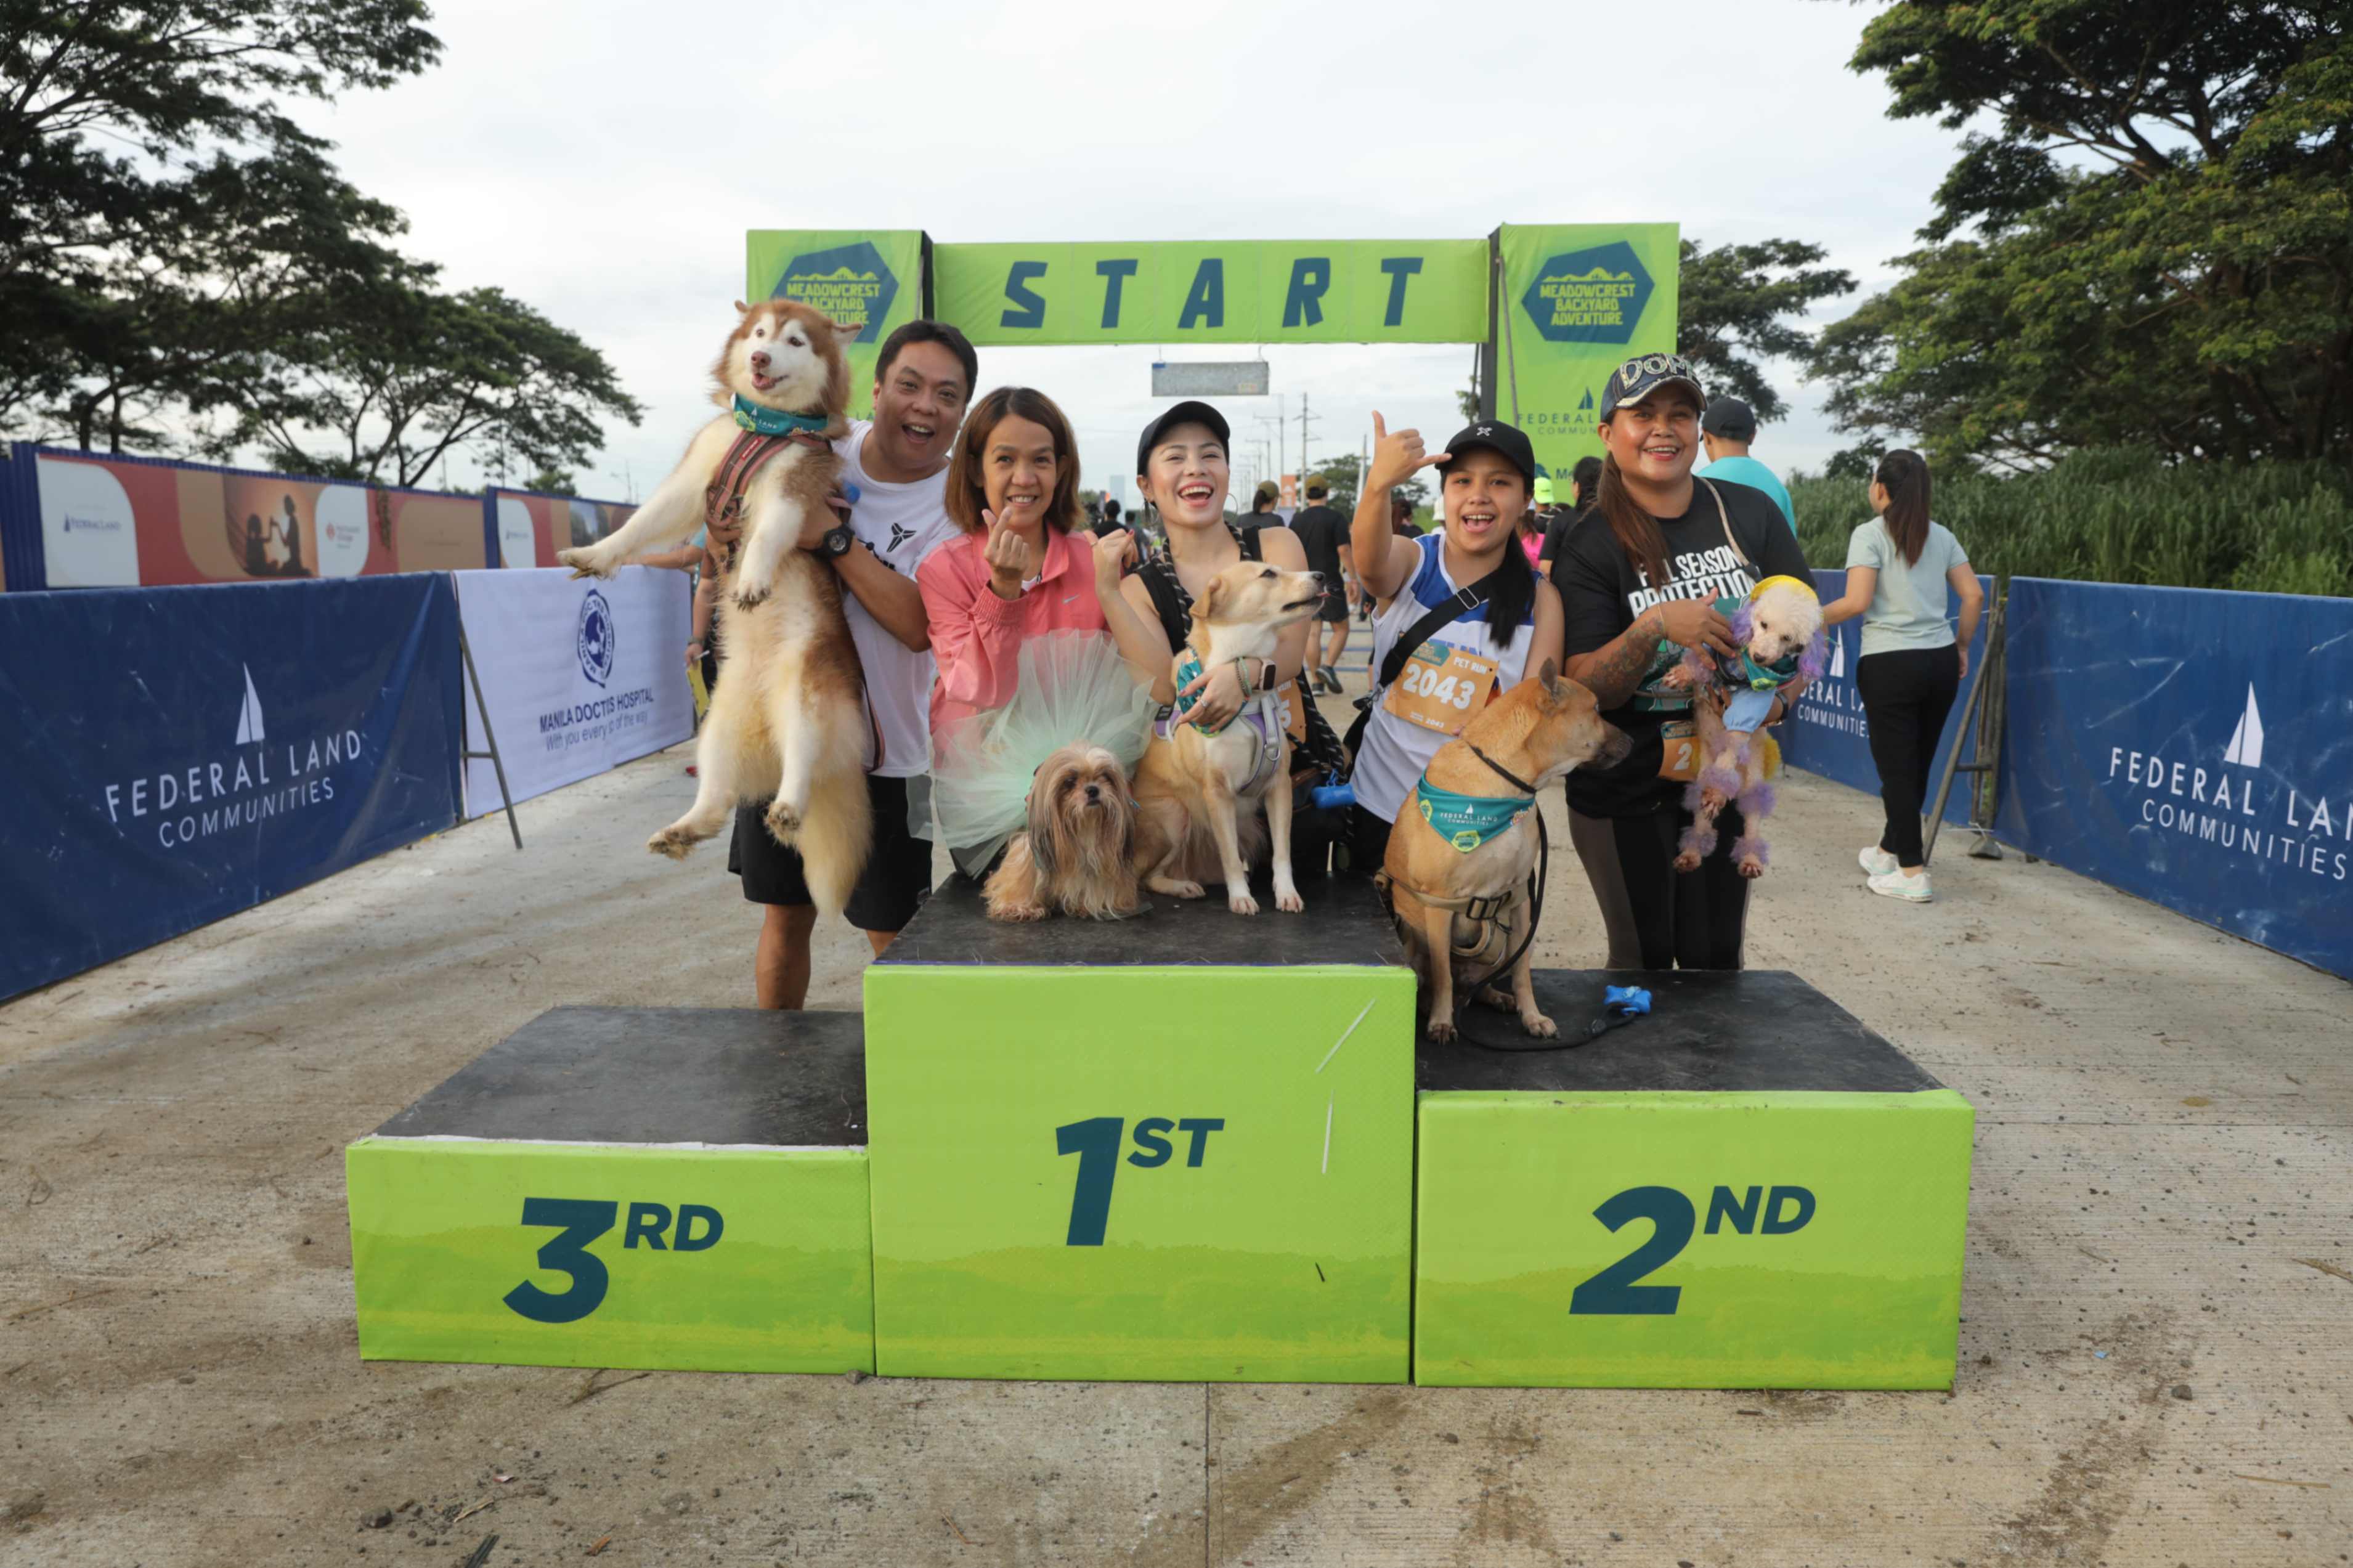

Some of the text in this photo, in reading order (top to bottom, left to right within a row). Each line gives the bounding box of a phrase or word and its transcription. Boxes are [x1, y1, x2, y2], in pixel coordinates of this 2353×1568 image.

[787, 282, 880, 296] MEADOWCREST
[999, 258, 1424, 328] START
[1540, 283, 1636, 298] MEADOWCREST
[1555, 297, 1620, 311] BACKYARD
[1550, 311, 1624, 326] ADVENTURE
[1518, 413, 1594, 424] FEDERAL
[1402, 663, 1476, 710] 2043
[1454, 656, 1488, 675] PET RUN
[540, 708, 574, 734] MANILA
[617, 687, 654, 710] HOSPITAL
[1797, 704, 1870, 739] COMMUNITIE
[564, 730, 580, 750] you
[582, 723, 608, 742] every
[105, 729, 361, 823] FEDERAL LAND
[2110, 747, 2353, 841] FEDERAL LA
[159, 777, 334, 848] COMMUNITIES
[1439, 812, 1473, 820] FEDERAL
[2142, 799, 2347, 880] COMMUNITIES
[1055, 1117, 1225, 1246] 1ST
[502, 1197, 725, 1323] 3RD
[1569, 1185, 1816, 1315] 2ND
